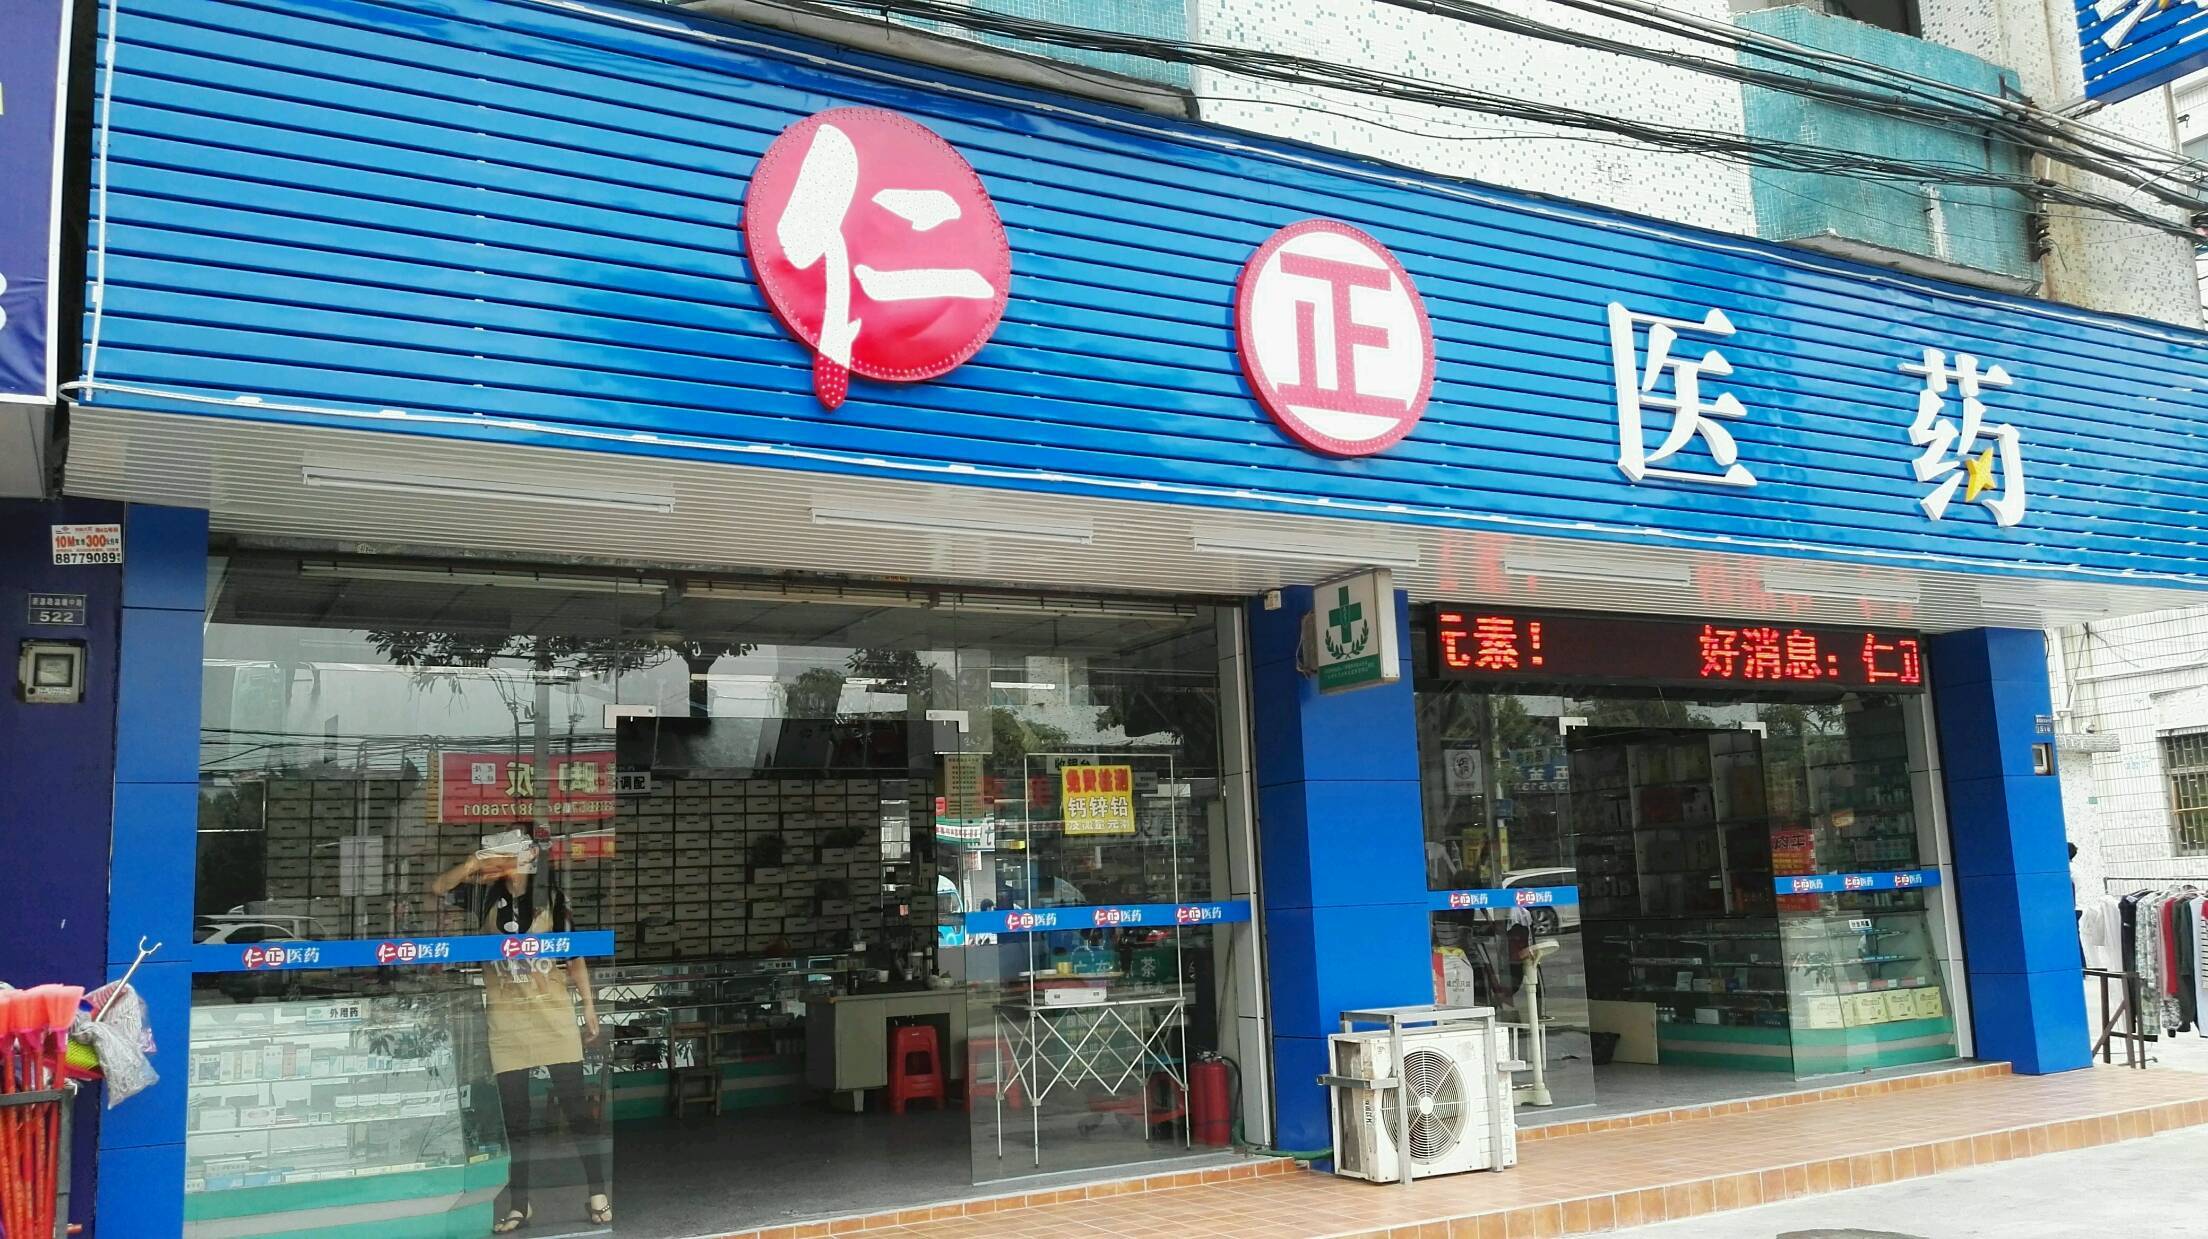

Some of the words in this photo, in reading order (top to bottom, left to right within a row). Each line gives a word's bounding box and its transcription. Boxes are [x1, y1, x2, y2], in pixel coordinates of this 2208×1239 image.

[774, 122, 2027, 528] 仁正医药
[55, 552, 116, 564] 88779089
[39, 611, 74, 623] 522
[1067, 796, 1129, 818] 钙锌铅
[1450, 893, 1488, 907] 仁正医药
[1516, 891, 1553, 905] 仁正医药
[1007, 912, 1057, 930] 仁正医药
[1095, 908, 1142, 926] 仁正医药
[1177, 906, 1222, 922] 仁正医药
[378, 942, 450, 963] 仁正医药
[504, 937, 570, 957] 仁正医药
[244, 946, 321, 968] 仁正医药
